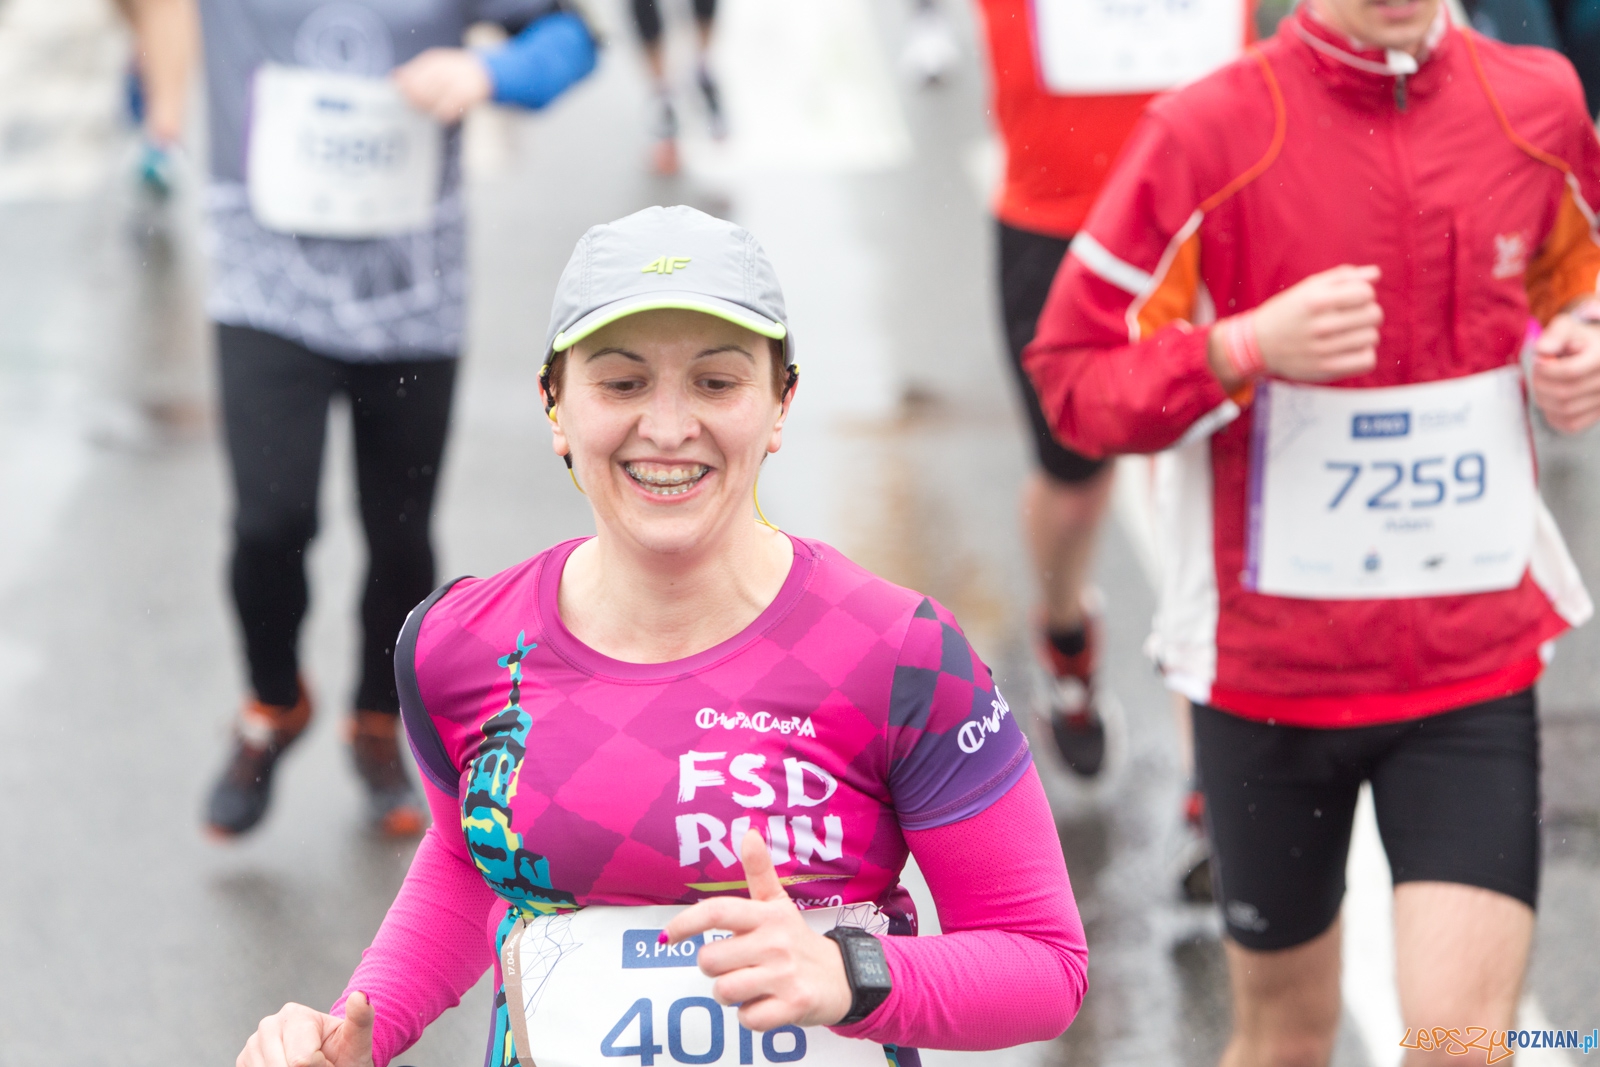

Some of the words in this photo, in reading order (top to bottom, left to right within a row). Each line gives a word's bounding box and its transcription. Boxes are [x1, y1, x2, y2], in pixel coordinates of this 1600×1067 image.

[1325, 451, 1487, 512] 7259
[677, 750, 839, 809] FSD
[675, 812, 844, 869] RUN
[654, 940, 696, 958] PKO
